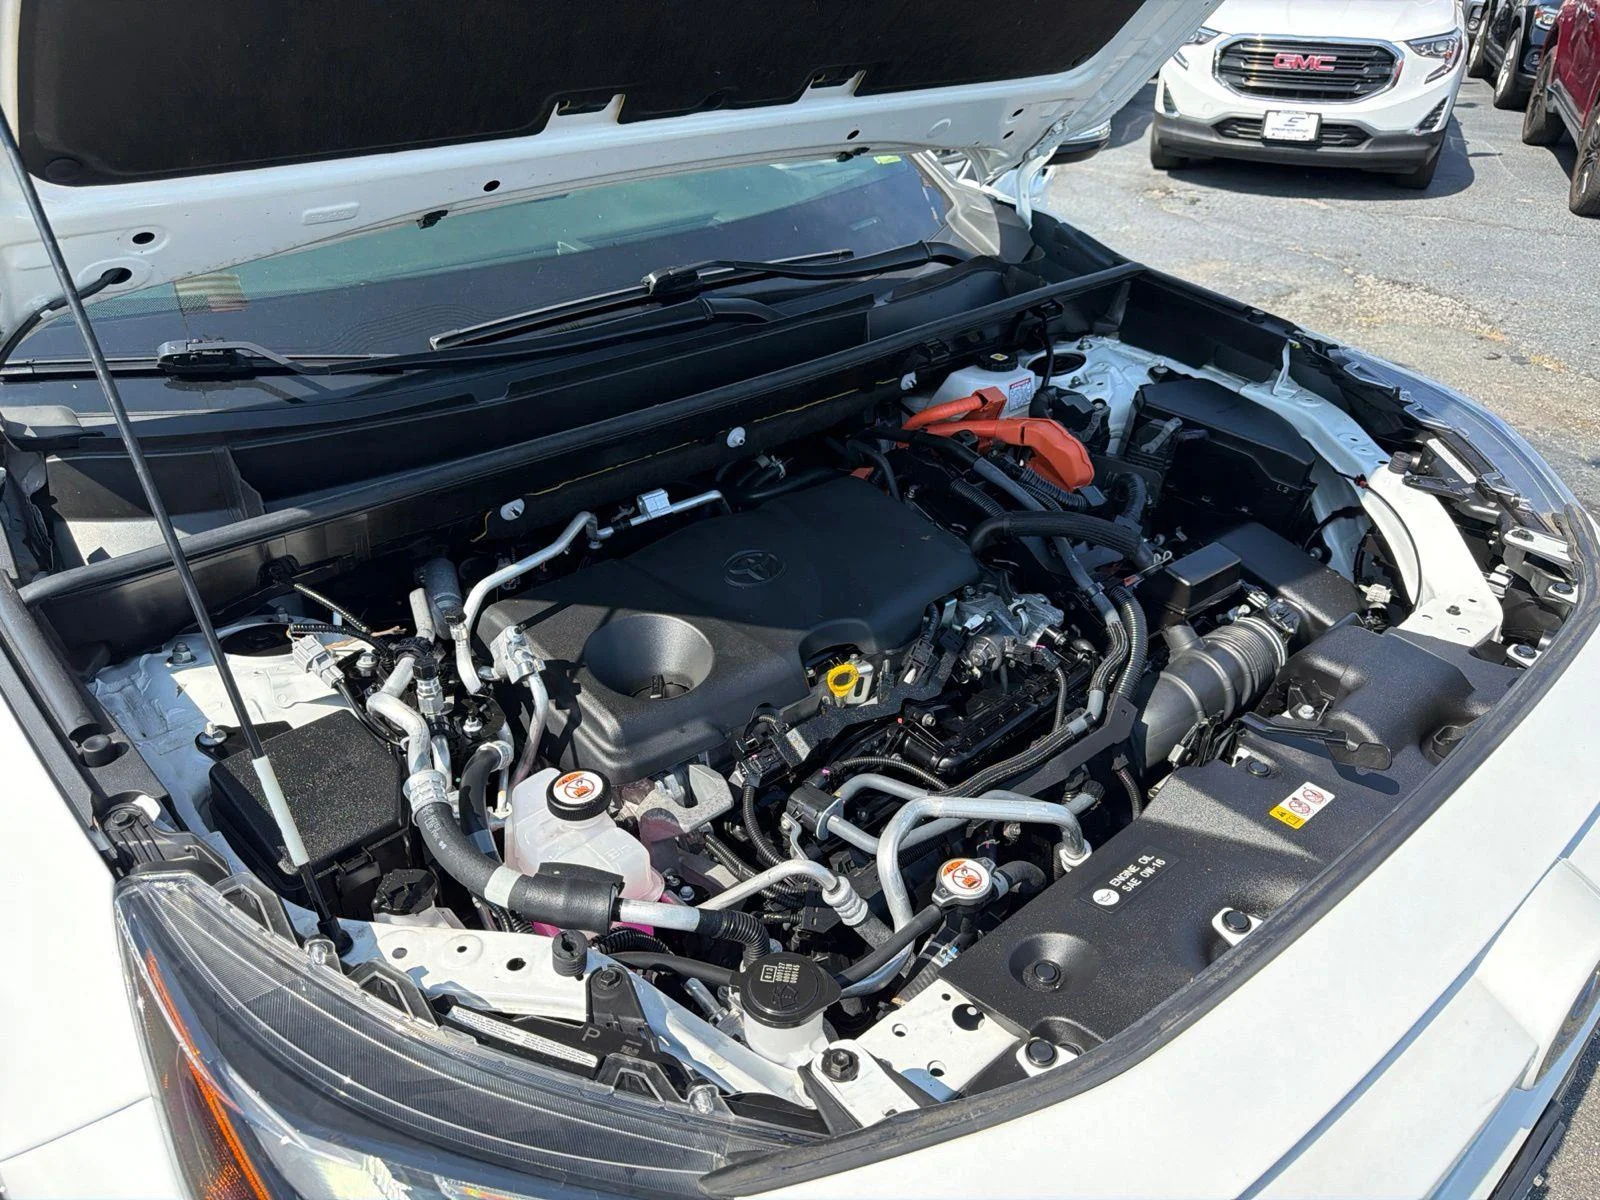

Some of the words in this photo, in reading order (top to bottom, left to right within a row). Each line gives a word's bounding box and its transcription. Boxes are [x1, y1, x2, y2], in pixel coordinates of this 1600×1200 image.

[1273, 53, 1337, 72] GMC
[1109, 864, 1140, 886] ENGINE
[1138, 855, 1155, 865] OIL
[1122, 878, 1142, 892] SAE
[581, 1026, 601, 1042] P
